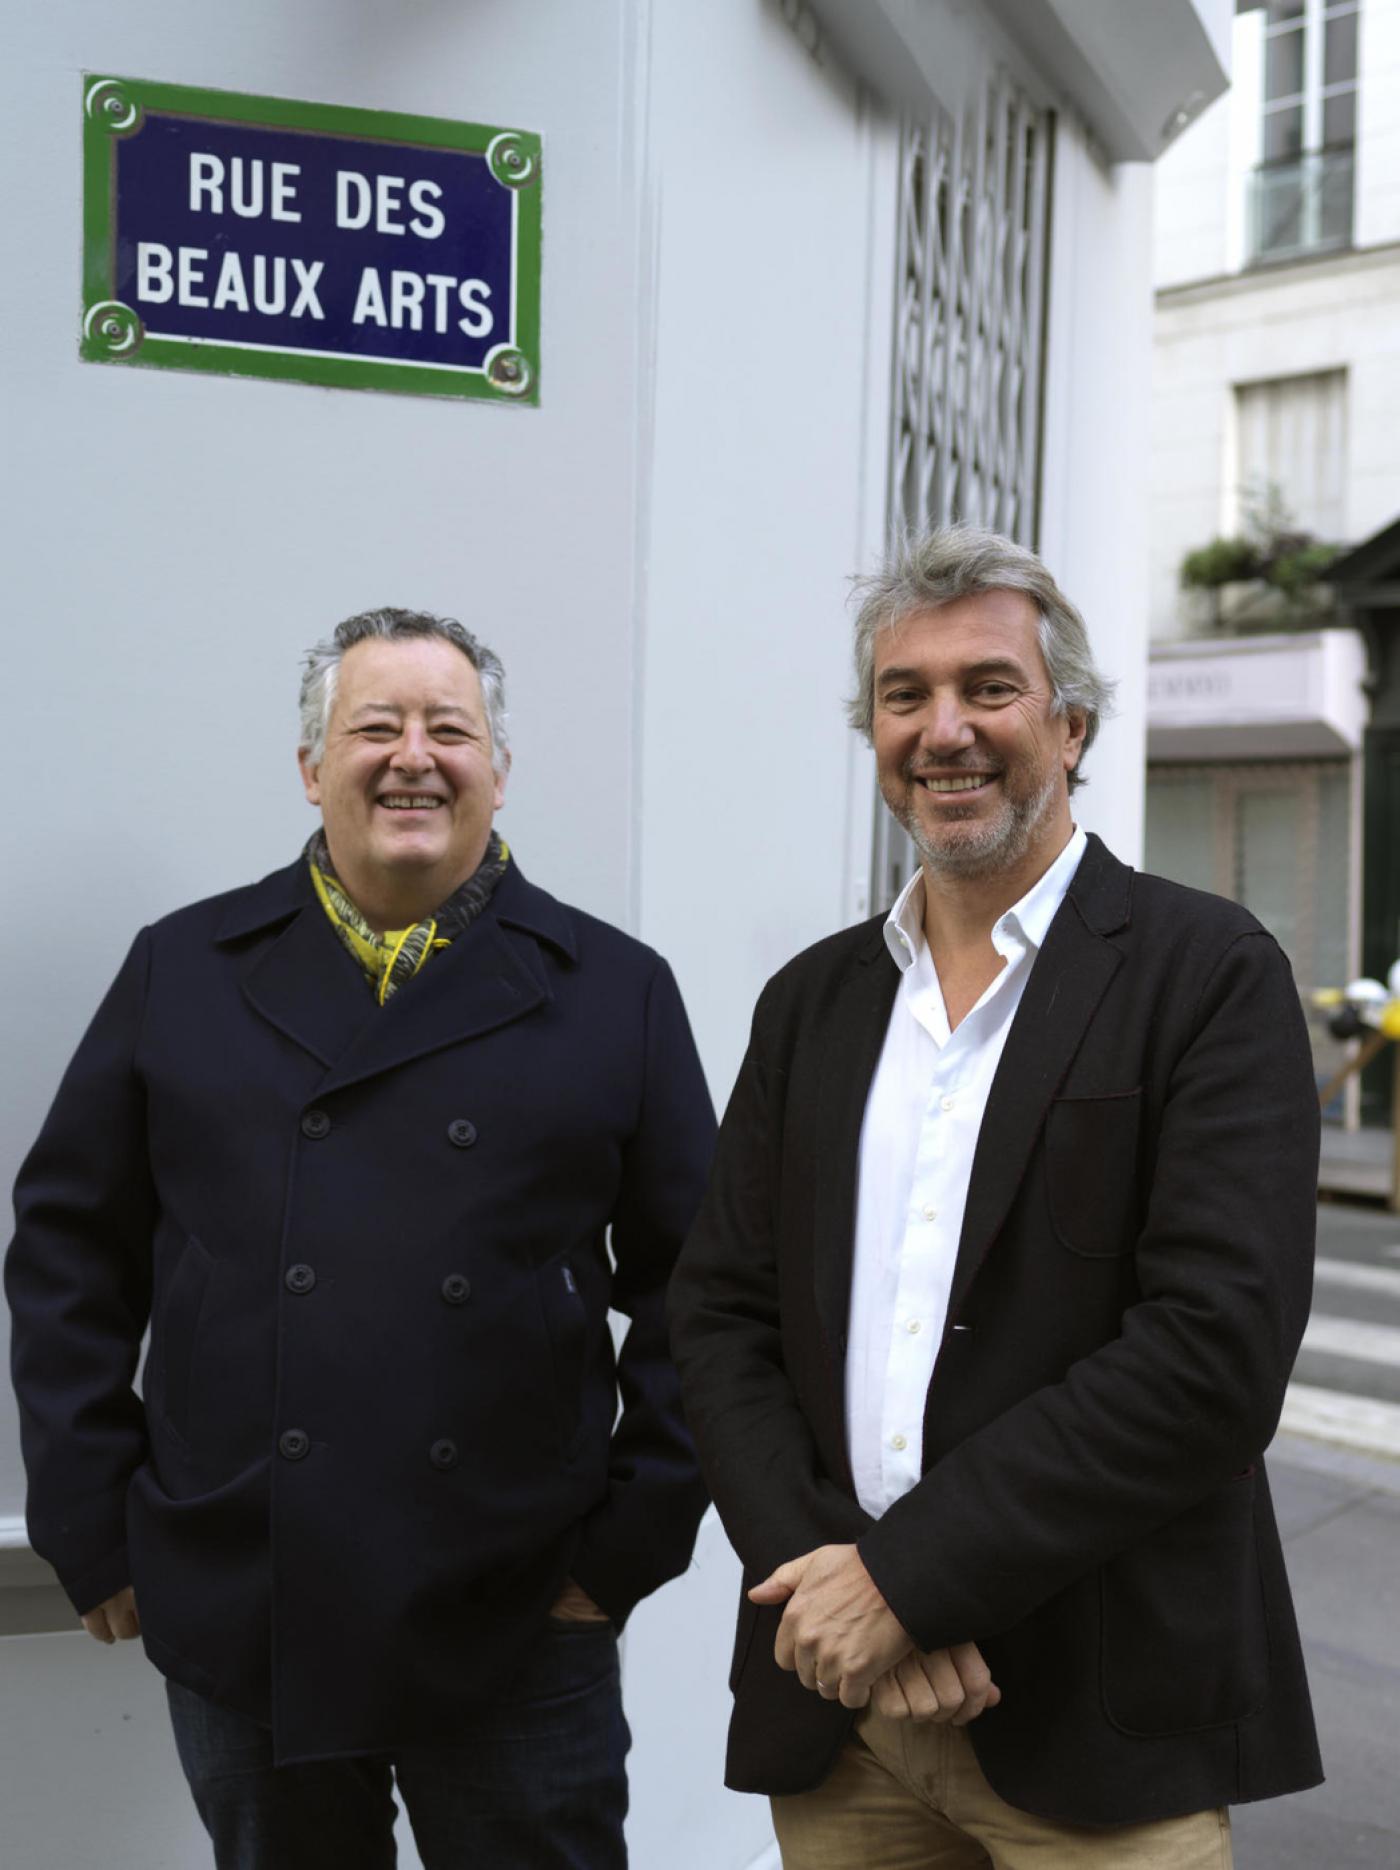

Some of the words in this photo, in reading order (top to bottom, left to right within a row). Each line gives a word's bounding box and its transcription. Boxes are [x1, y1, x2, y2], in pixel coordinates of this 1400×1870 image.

[189, 152, 301, 222] RUE
[336, 170, 445, 239] DES
[137, 242, 325, 320] BEAUX
[353, 267, 494, 338] ARTS
